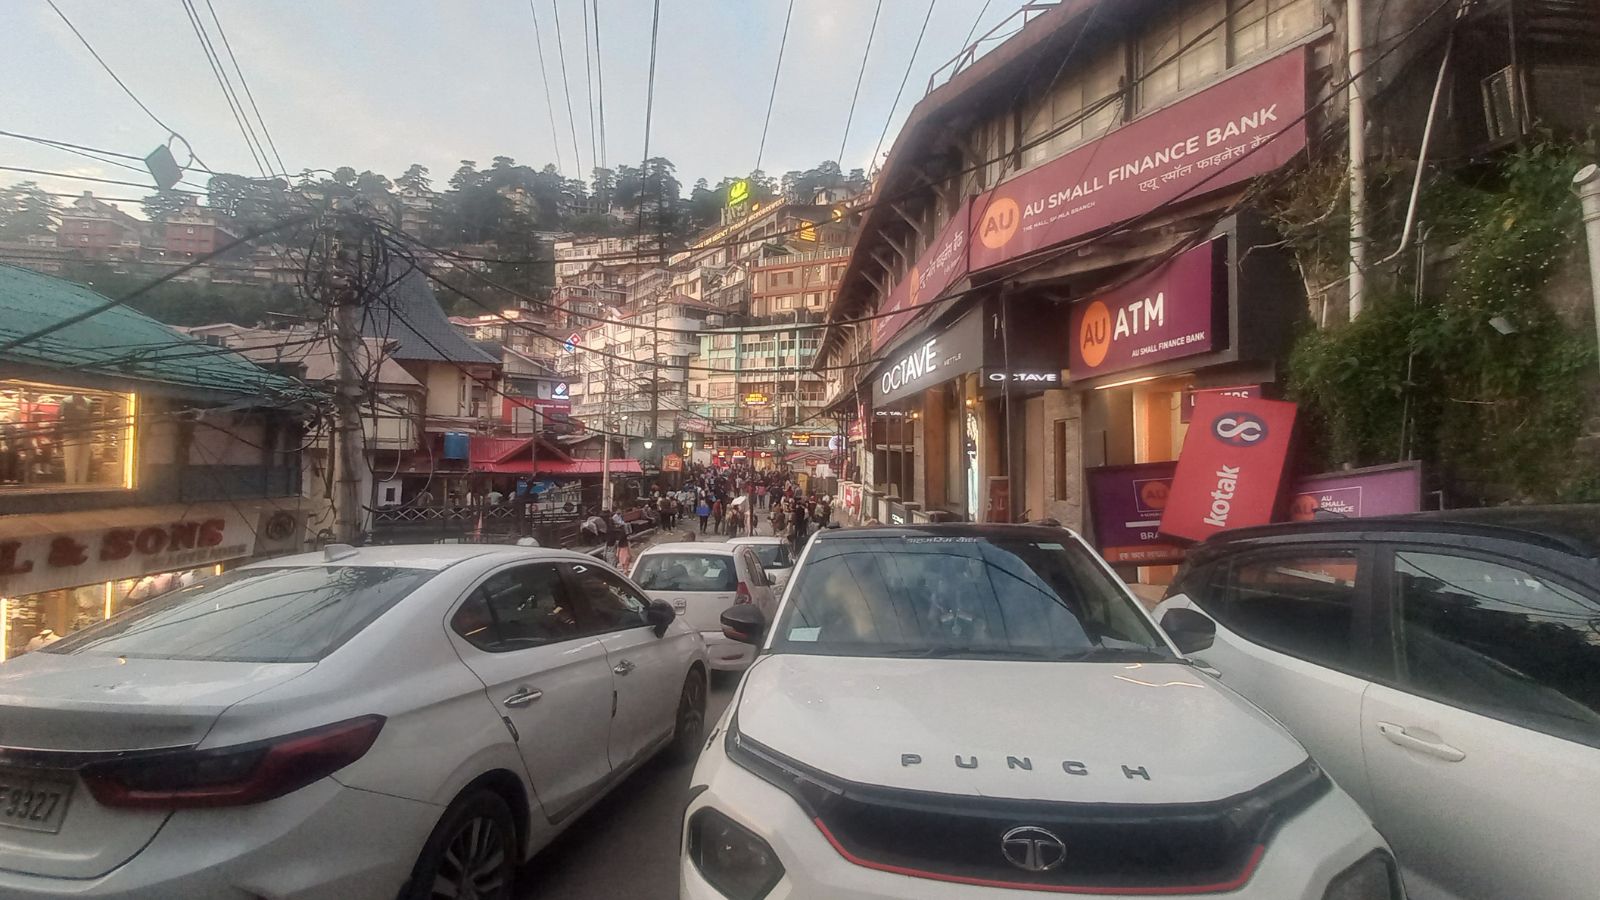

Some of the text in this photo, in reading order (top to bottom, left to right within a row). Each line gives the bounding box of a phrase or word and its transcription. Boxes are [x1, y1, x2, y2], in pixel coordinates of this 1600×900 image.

[1023, 103, 1277, 218] AU SMALL FINANCE BANK
[1138, 178, 1159, 192] एयू
[1161, 164, 1193, 183] स्मॉल
[1196, 143, 1246, 169] फाइनेंस
[984, 208, 1014, 237] AU
[1071, 201, 1096, 214] BRANCH
[1083, 318, 1106, 349] AU
[1114, 292, 1164, 341] ATM
[1132, 331, 1205, 357] AU SMALL FINANCE BANK
[882, 338, 937, 394] OCTAVE
[1204, 464, 1240, 527] kotak
[1321, 500, 1345, 508] SMALL
[48, 536, 88, 567] &
[99, 519, 225, 561] SONS
[901, 753, 1151, 780] PUNCH
